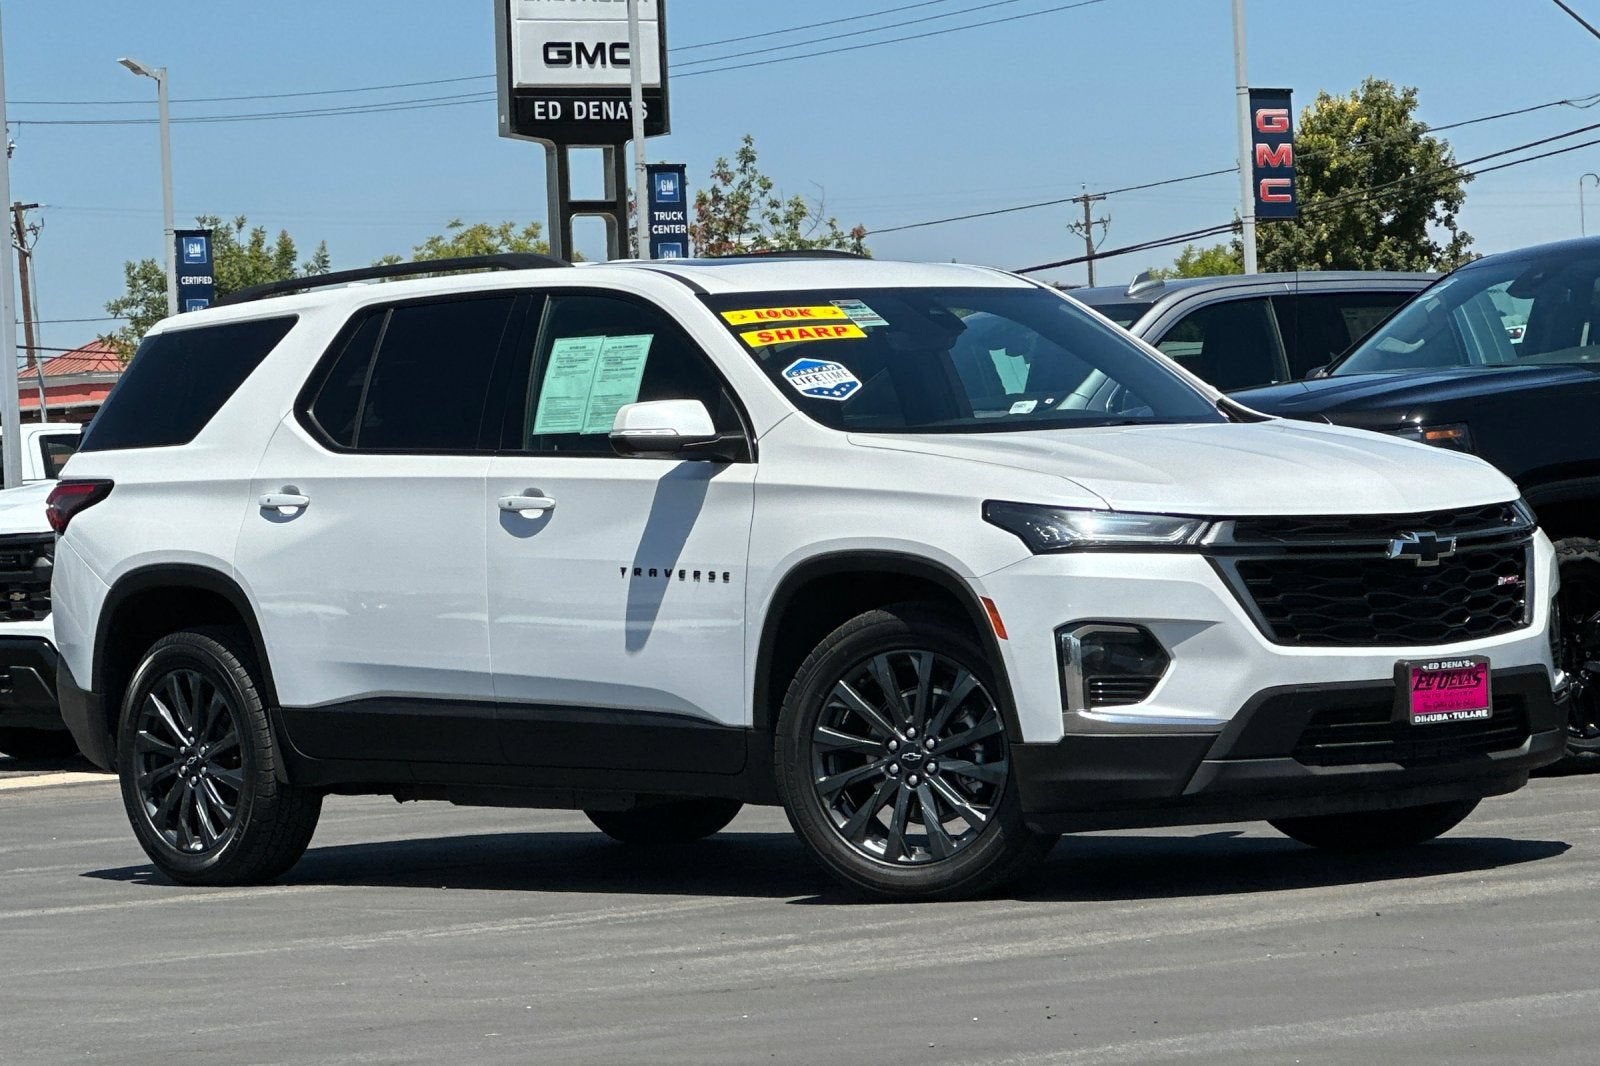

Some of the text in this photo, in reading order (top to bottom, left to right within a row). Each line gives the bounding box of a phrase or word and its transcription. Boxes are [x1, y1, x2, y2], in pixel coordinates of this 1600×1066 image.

[542, 41, 631, 65] GMC
[534, 101, 561, 120] ED
[1256, 108, 1293, 203] GMC
[661, 179, 674, 192] GM
[654, 211, 683, 221] TRUCK
[652, 224, 687, 234] CENTER
[189, 243, 201, 254] GM
[181, 276, 213, 285] CERTIFIED
[754, 308, 813, 320] LOOK
[757, 326, 849, 343] SHARP
[791, 370, 852, 386] LIFETIME
[620, 567, 730, 583] TRAVERSE
[1441, 659, 1471, 669] DENA'S
[1452, 709, 1488, 720] TULARE
